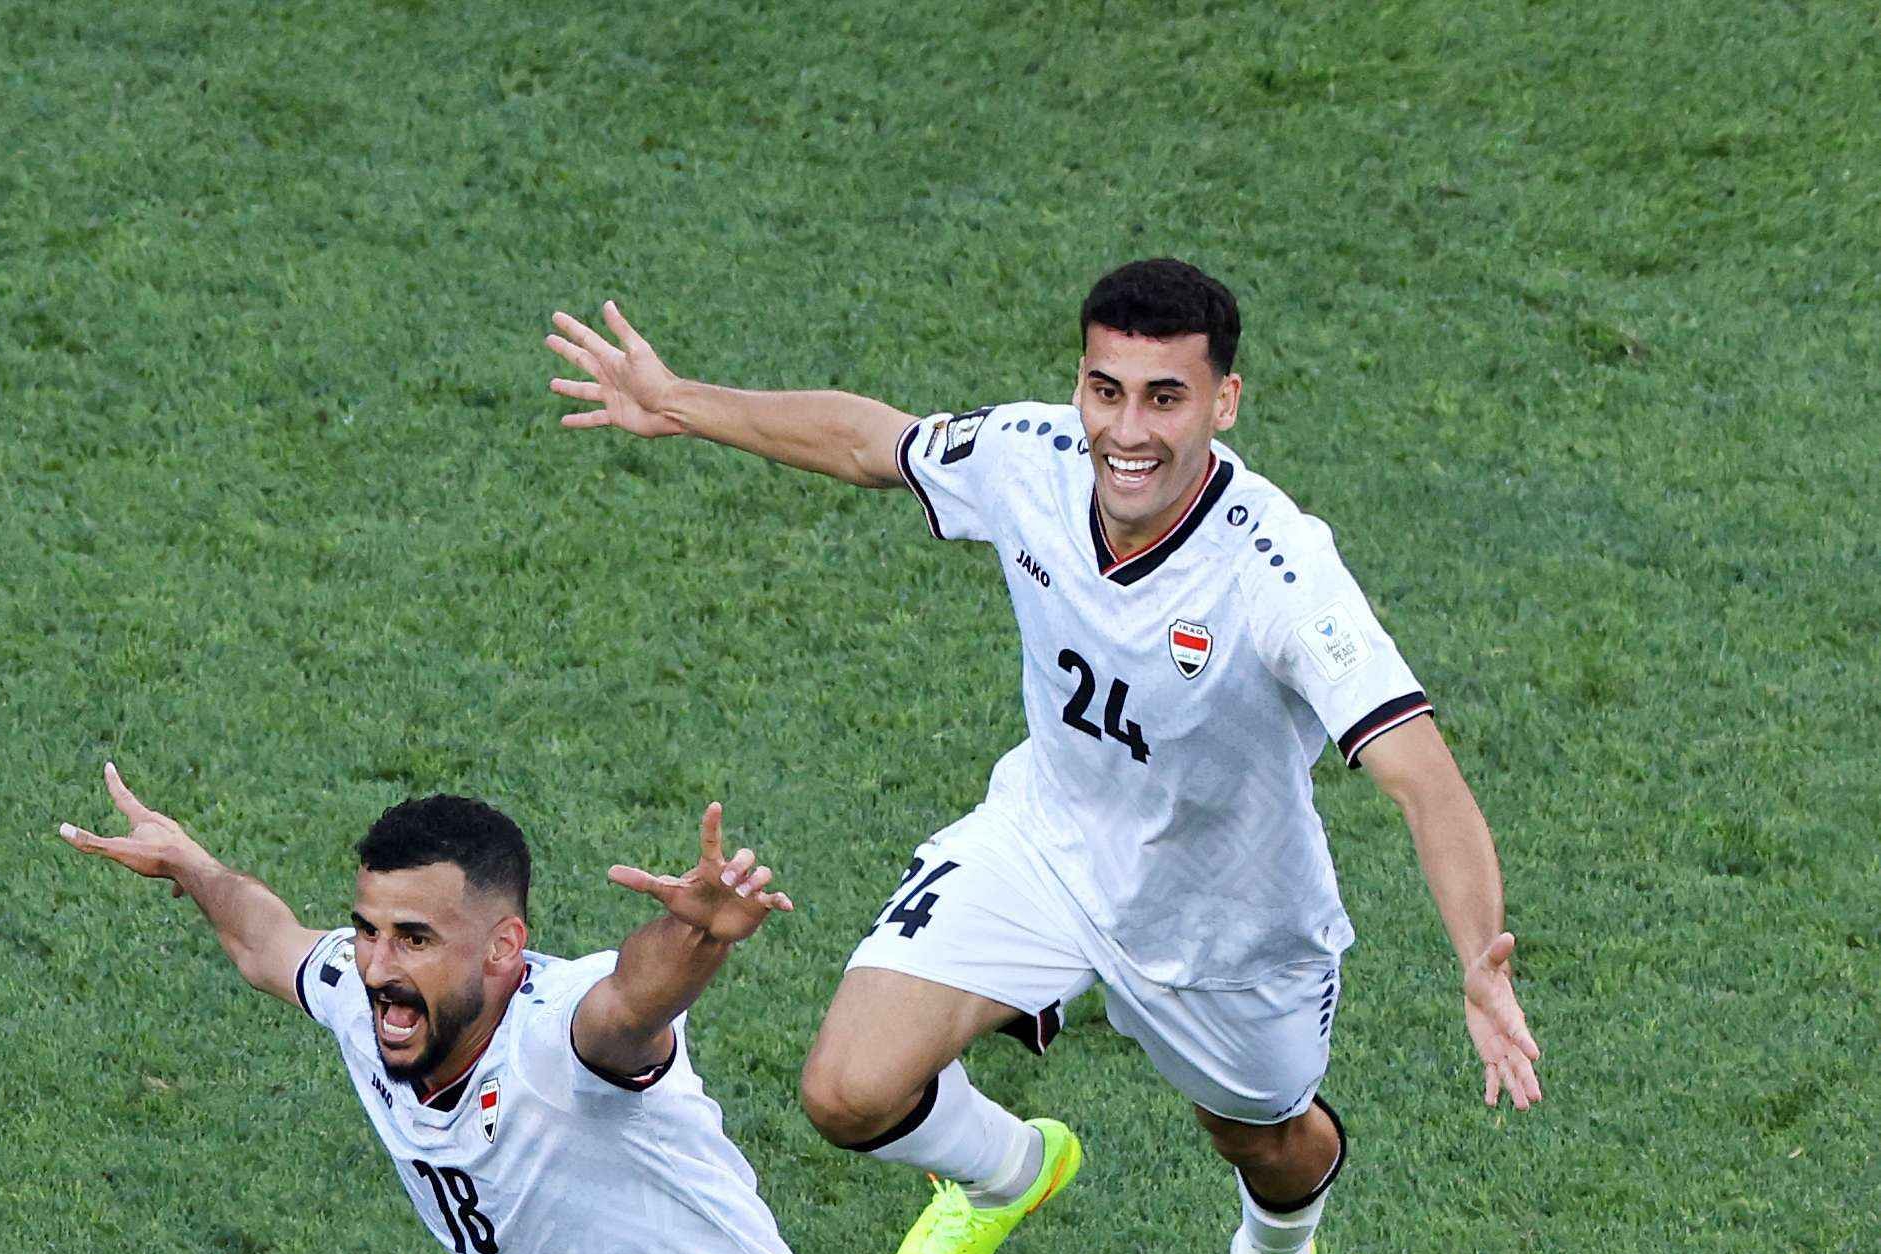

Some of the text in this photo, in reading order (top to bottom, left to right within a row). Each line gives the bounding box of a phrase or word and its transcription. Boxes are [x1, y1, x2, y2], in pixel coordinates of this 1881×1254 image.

[1016, 550, 1050, 588] JAKO
[1058, 648, 1151, 764] 24
[371, 1072, 393, 1110] JAKO
